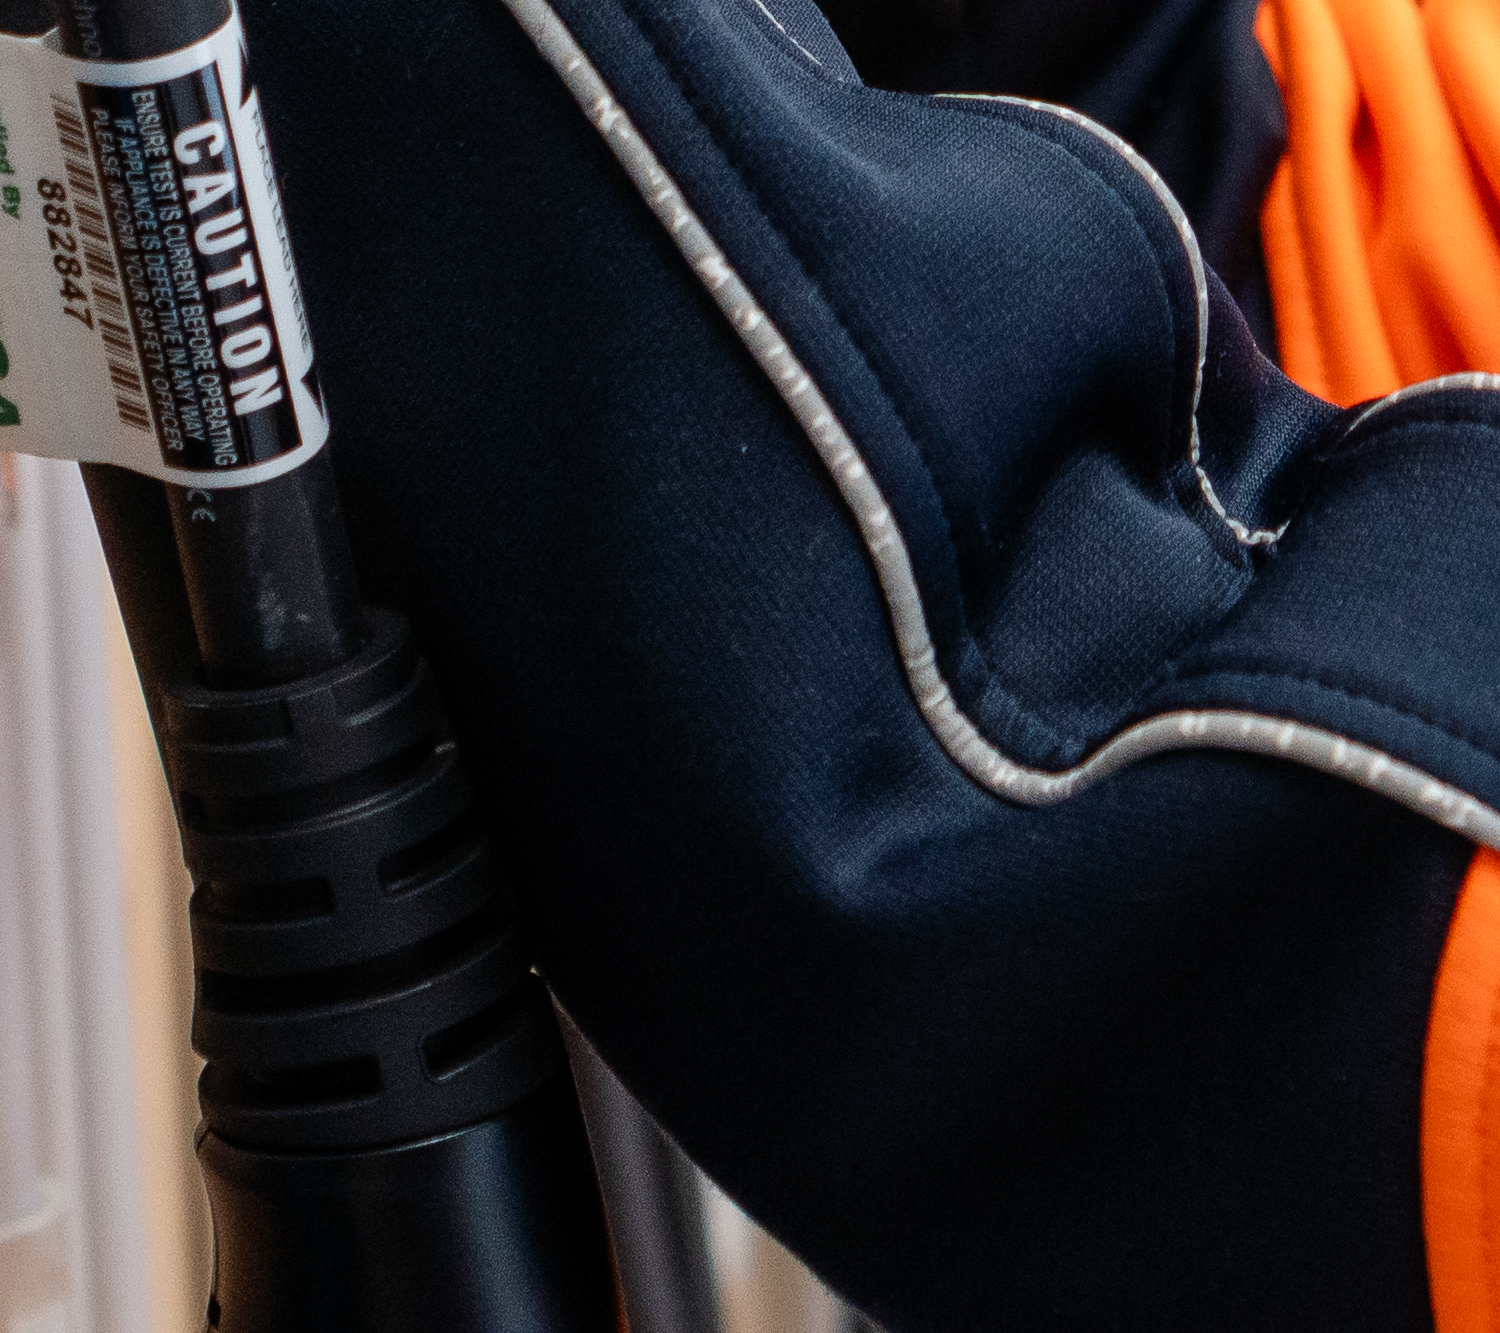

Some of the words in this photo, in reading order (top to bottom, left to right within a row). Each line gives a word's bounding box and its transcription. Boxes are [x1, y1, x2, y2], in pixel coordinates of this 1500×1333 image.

[90, 107, 122, 177] PLEASE
[114, 118, 136, 134] IF
[131, 89, 169, 158] ENSURE
[1, 184, 22, 220] By
[118, 137, 158, 231] APPLIANCE
[149, 159, 179, 202] TEST
[159, 204, 183, 222] IS
[107, 181, 138, 250] INFORM
[140, 234, 163, 251] IS
[37, 177, 94, 330] 882847
[123, 254, 150, 303] YOUR
[162, 224, 202, 301] CURRENT
[173, 120, 285, 418] CAUTION
[144, 253, 184, 345] DEFECTIVE
[134, 306, 165, 373] SAFETY
[166, 347, 188, 365] IN
[180, 304, 217, 371] BEFORE
[151, 376, 185, 451] OFFICER
[172, 367, 196, 402] ANY
[179, 404, 205, 441] WAY
[196, 373, 239, 466] OPERATING
